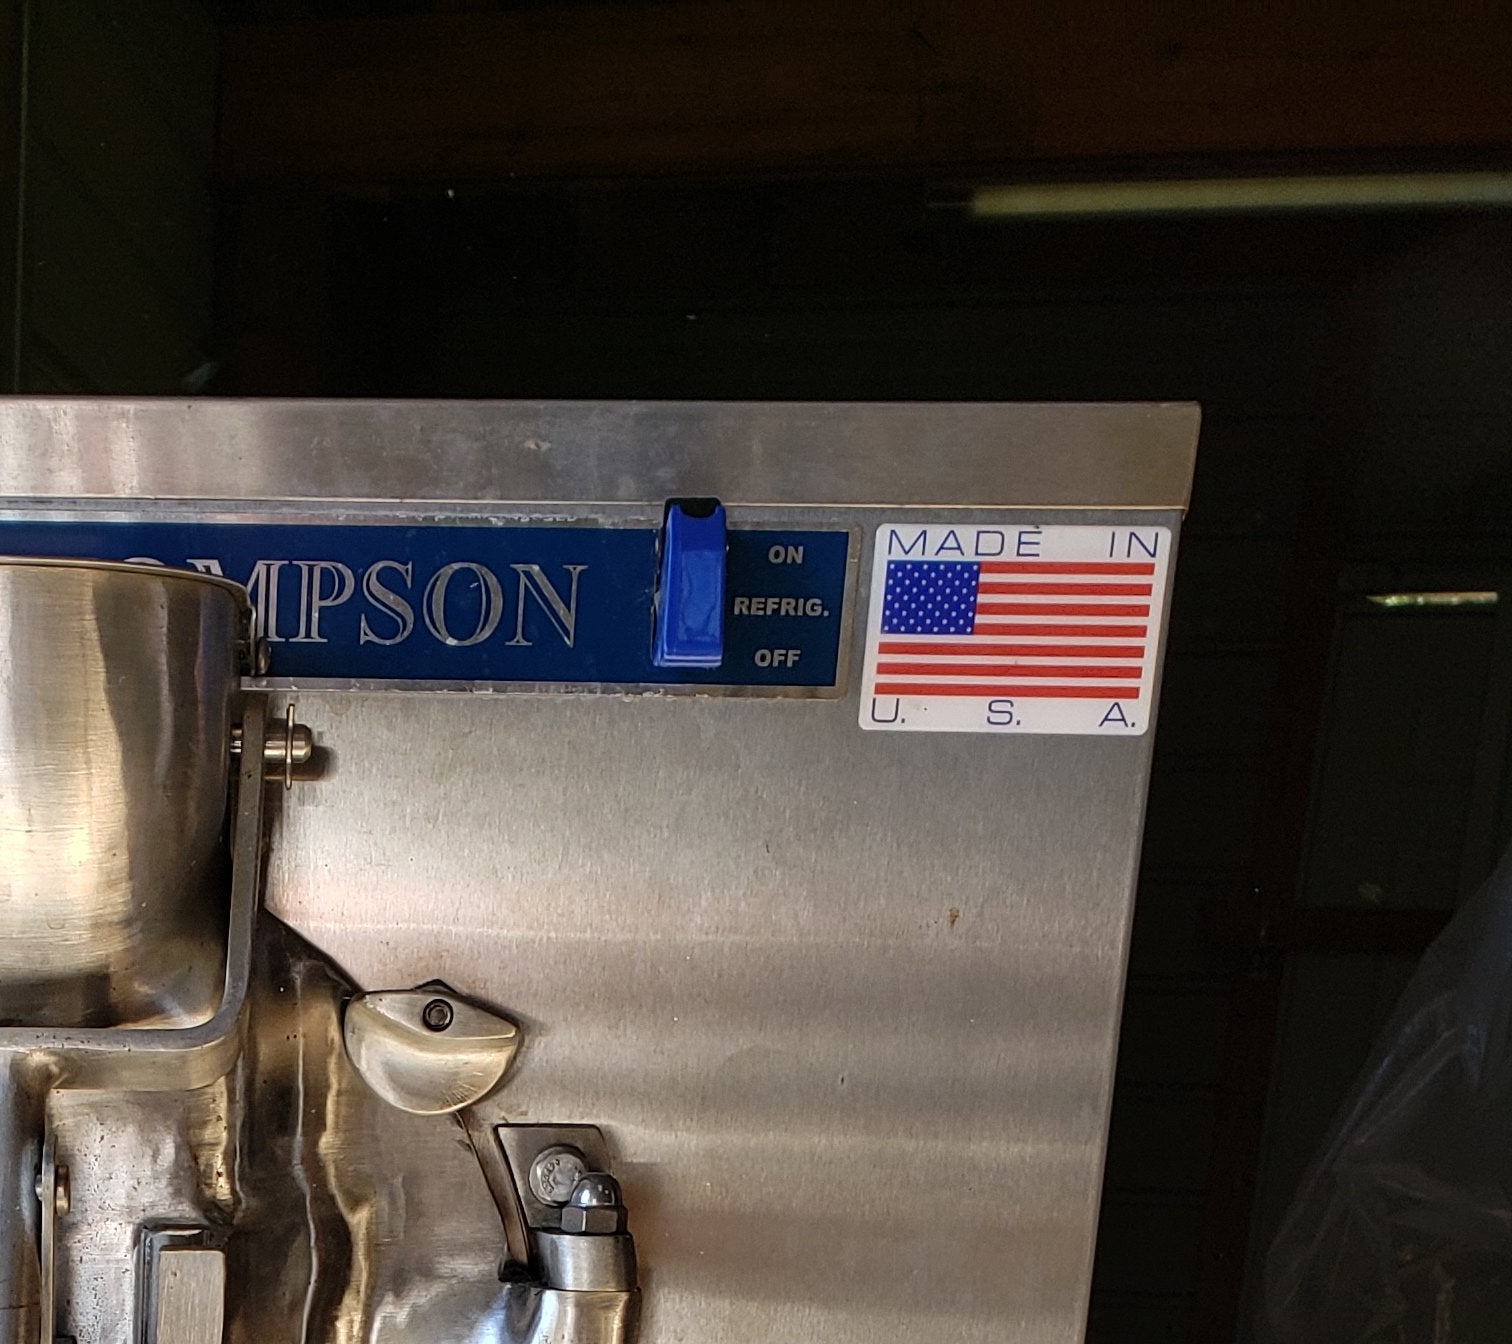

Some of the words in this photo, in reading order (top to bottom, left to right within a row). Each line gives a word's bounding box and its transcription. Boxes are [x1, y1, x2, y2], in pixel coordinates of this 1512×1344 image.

[887, 528, 1040, 559] MADE
[1108, 528, 1160, 559] IN
[769, 545, 803, 564] ON
[734, 598, 829, 616] REFRIG.
[755, 649, 801, 667] OFF
[872, 697, 906, 725] U.
[986, 698, 1021, 727] S.
[1100, 702, 1138, 728] A.
